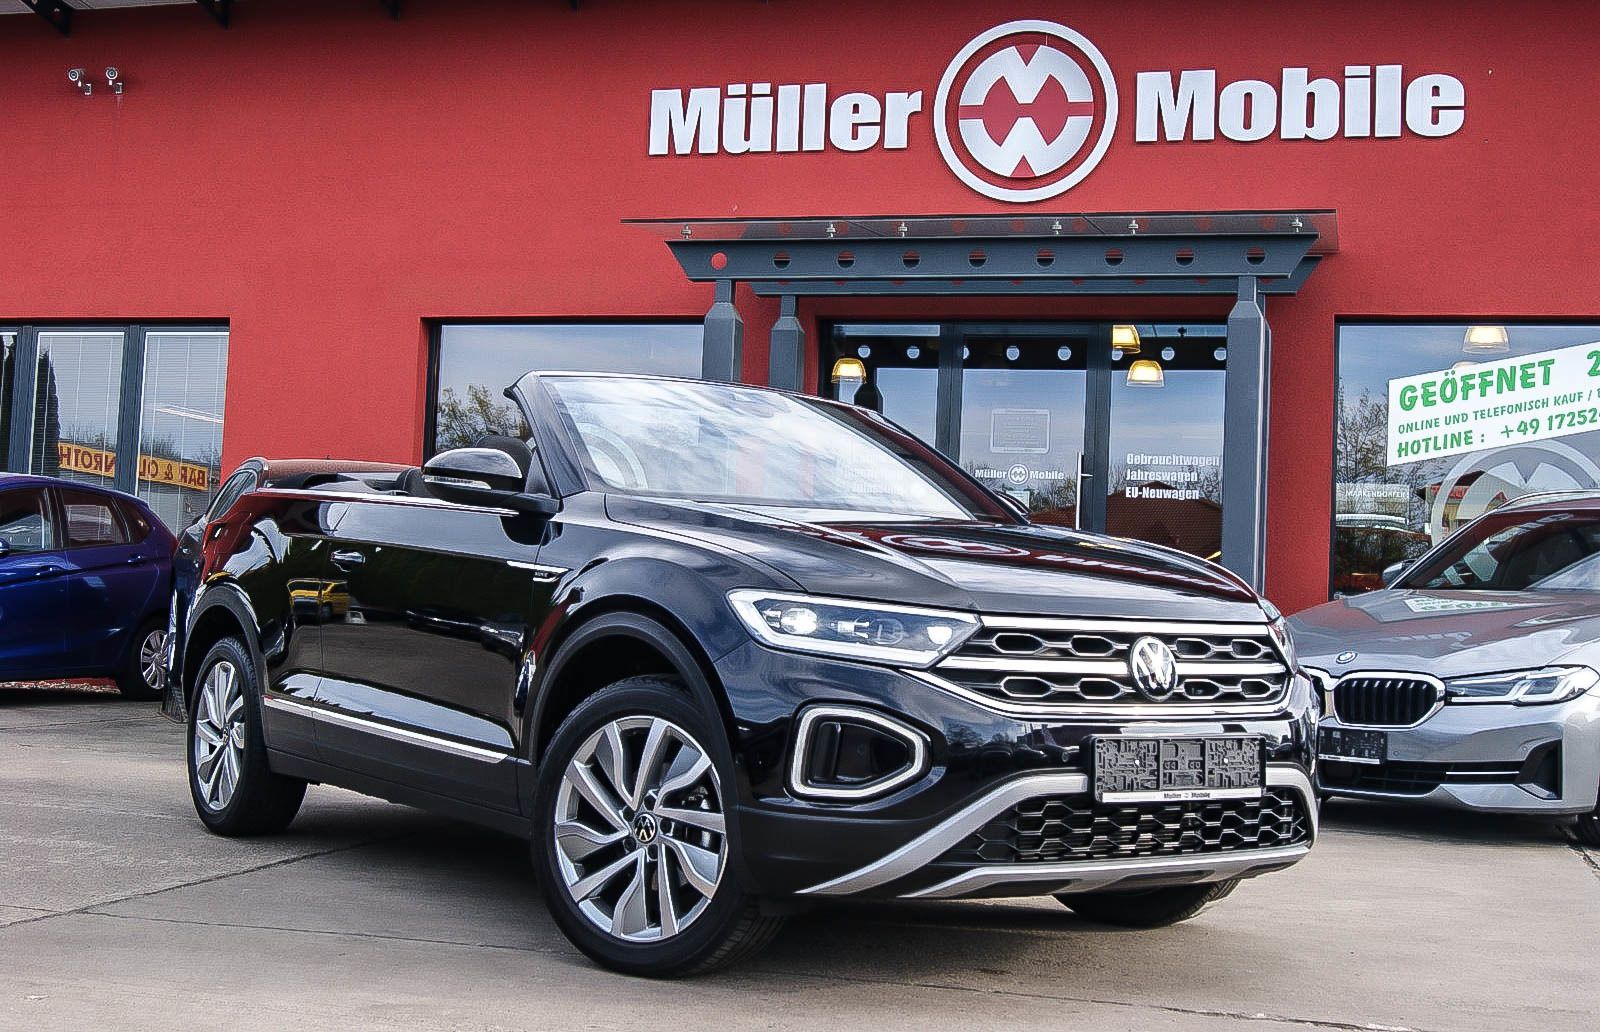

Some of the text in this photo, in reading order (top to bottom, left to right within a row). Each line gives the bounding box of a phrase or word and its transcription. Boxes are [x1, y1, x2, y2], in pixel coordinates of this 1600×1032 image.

[649, 65, 1464, 155] Müller Mobile
[1400, 359, 1555, 411] GEÖFFNET
[1398, 418, 1440, 434] ONLINE
[1444, 413, 1469, 425] UND
[1473, 397, 1549, 420] TELEFONISCH
[1553, 391, 1583, 406] KAUF
[1397, 430, 1473, 458] HOTLINE
[1500, 418, 1540, 438] +49
[1547, 407, 1600, 430] 17252
[975, 468, 1065, 479] Müller Mobile
[1126, 453, 1220, 466] Gebrauchtwagen
[1126, 469, 1198, 482] Jahreswagen
[1125, 486, 1199, 500] EU-Neuwagen
